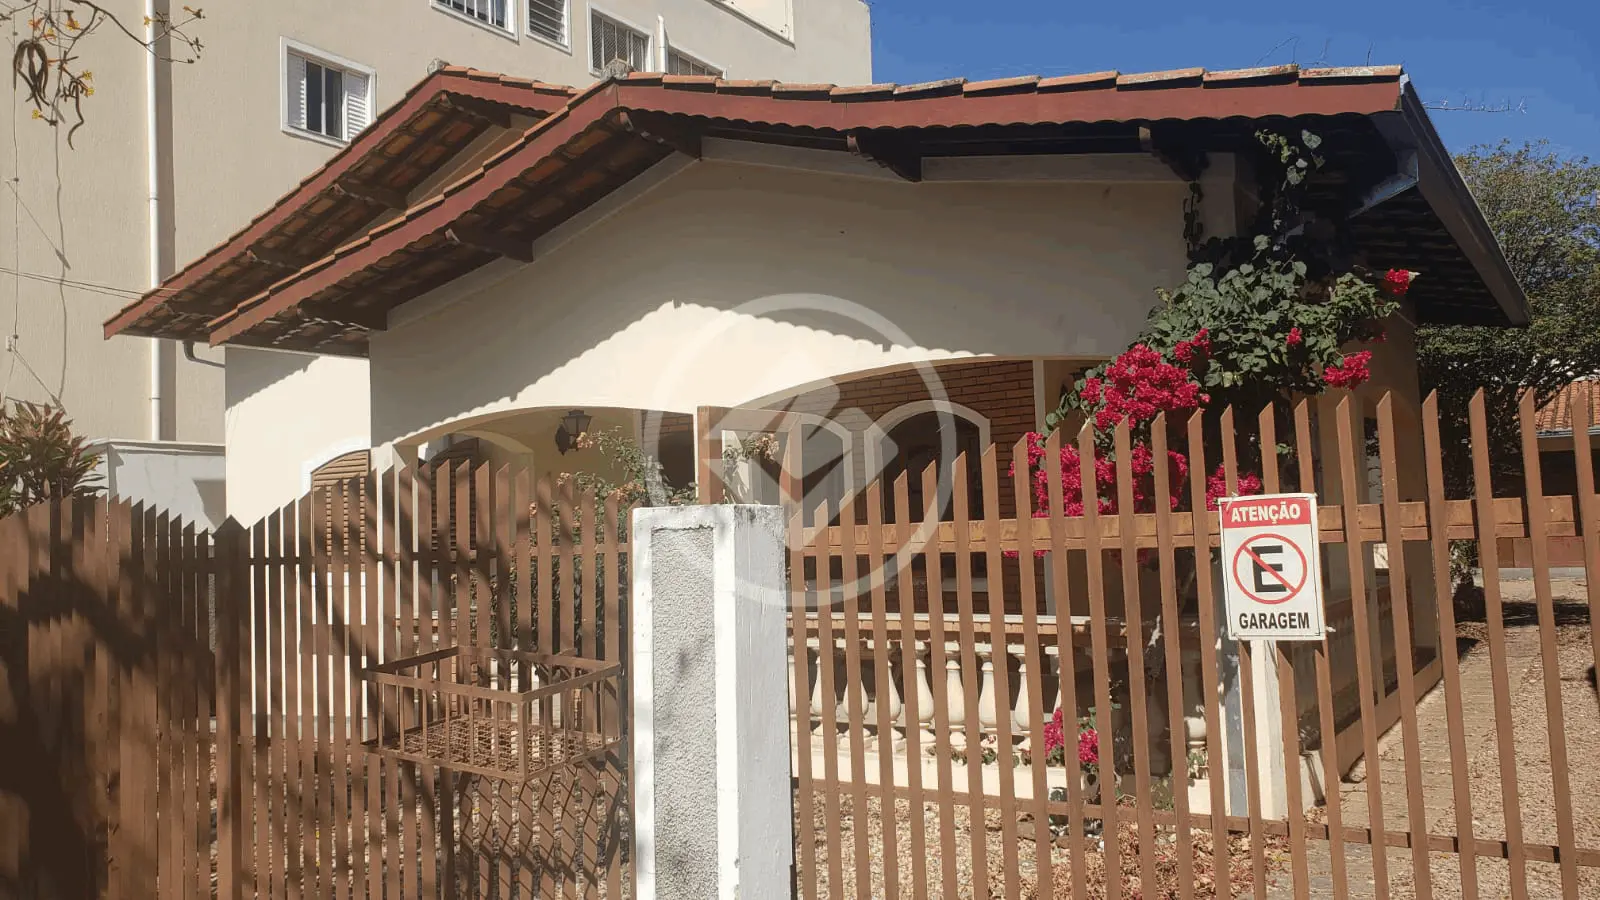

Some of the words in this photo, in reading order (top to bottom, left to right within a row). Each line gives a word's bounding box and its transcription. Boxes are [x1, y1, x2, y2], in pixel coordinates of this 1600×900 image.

[1231, 501, 1301, 524] ATENÇÃO
[1251, 545, 1287, 593] E
[1239, 612, 1310, 629] GARAGEM
